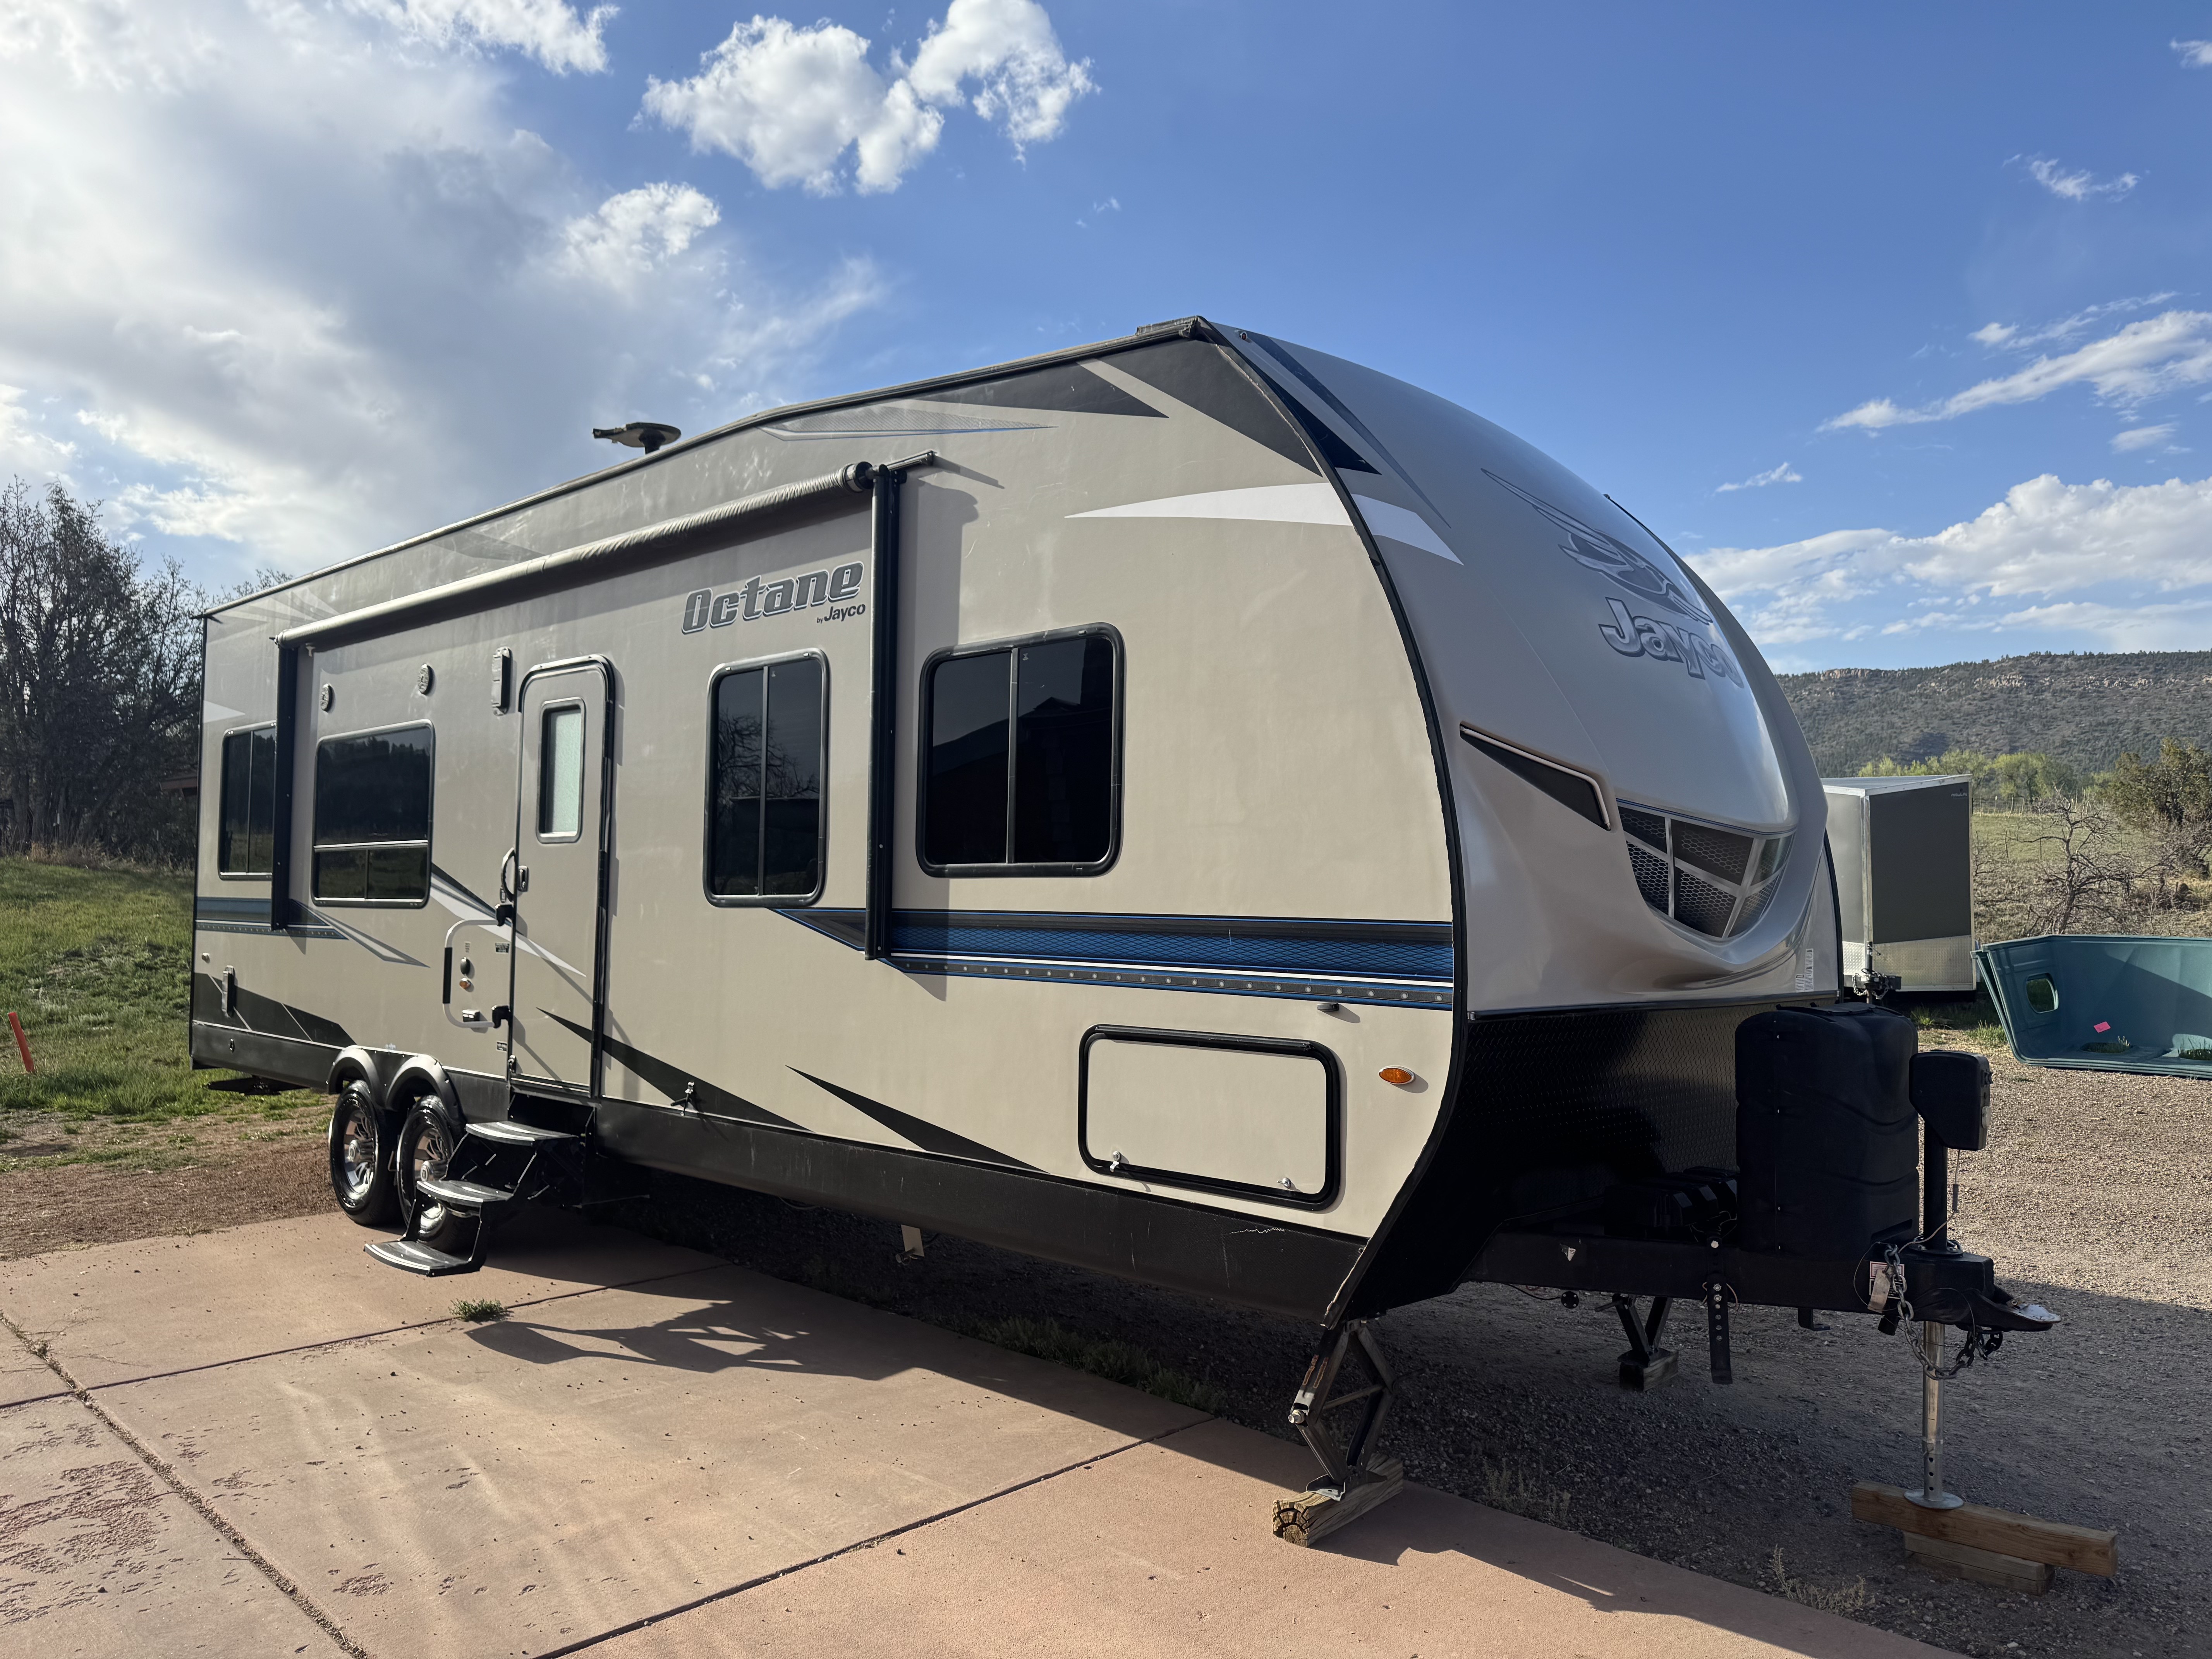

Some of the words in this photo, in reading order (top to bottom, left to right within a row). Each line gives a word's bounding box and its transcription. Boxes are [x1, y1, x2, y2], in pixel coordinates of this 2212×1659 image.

[682, 561, 864, 634] Octane
[824, 604, 866, 622] Jayco
[1598, 597, 1744, 688] Jayco
